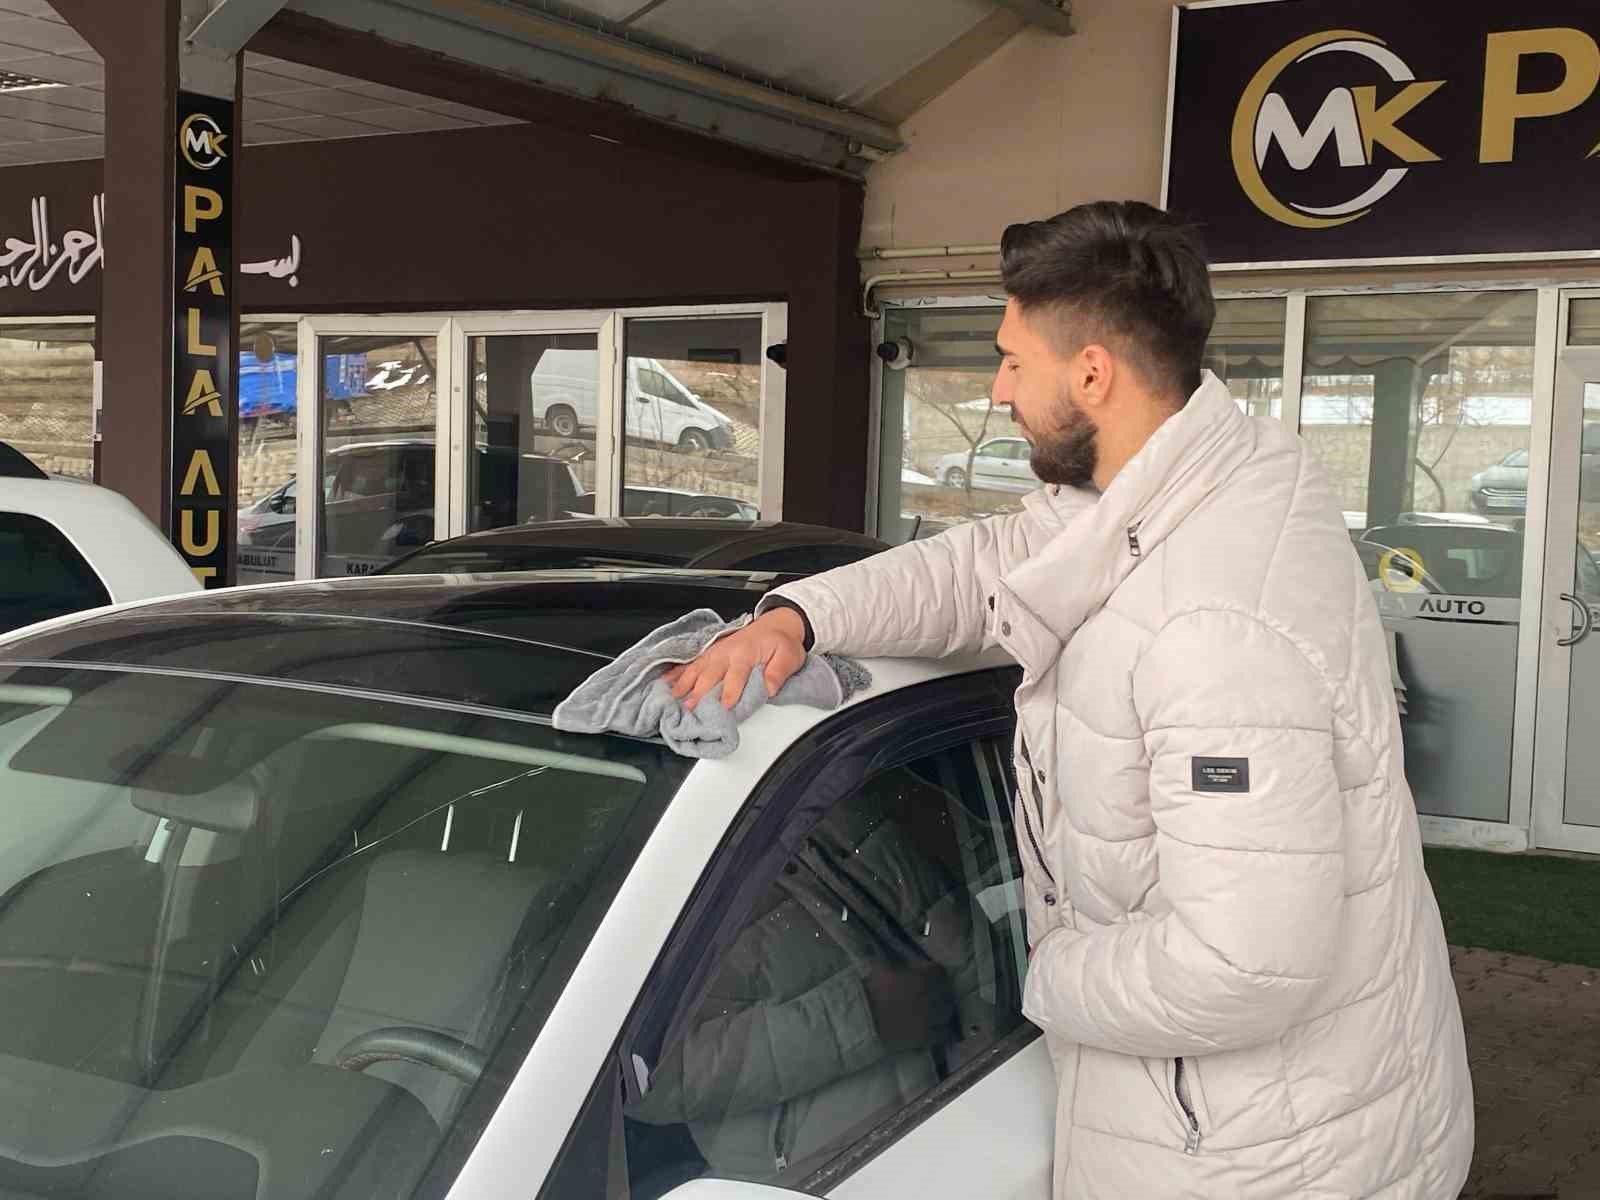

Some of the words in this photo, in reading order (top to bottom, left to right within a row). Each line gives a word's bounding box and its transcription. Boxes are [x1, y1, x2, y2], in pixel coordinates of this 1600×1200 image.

[1478, 27, 1600, 164] P
[182, 184, 225, 417] PALA
[1418, 598, 1486, 616] AUTO
